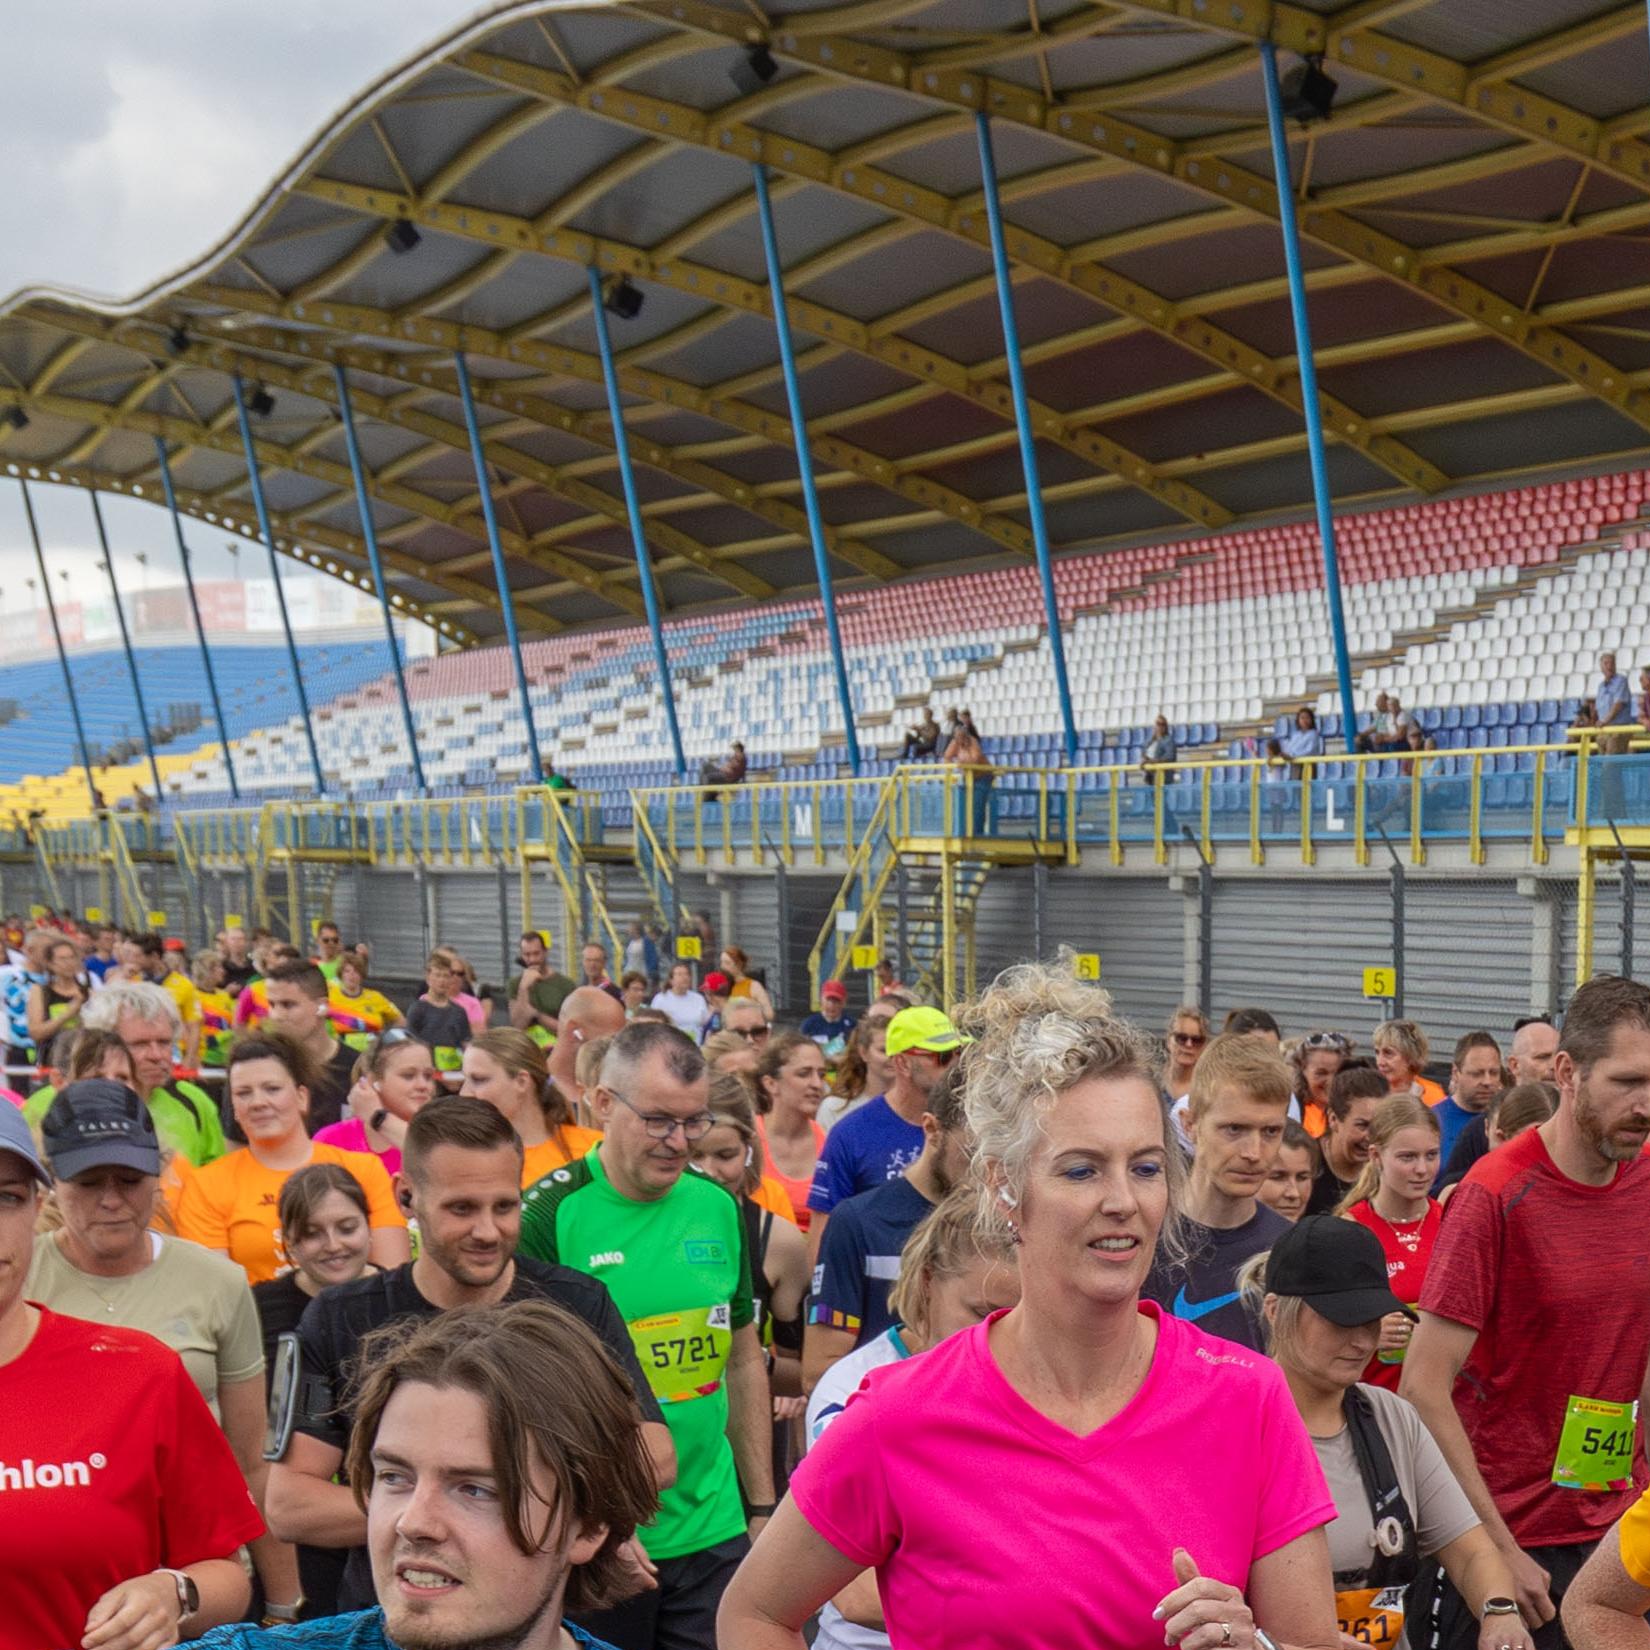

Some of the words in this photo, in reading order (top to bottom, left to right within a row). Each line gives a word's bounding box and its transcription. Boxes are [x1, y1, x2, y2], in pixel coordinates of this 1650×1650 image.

[794, 804, 812, 836] M
[1326, 788, 1344, 830] L
[684, 940, 695, 957] 8
[1078, 957, 1092, 978] 6
[1372, 972, 1385, 995] 5
[588, 1251, 625, 1268] JAKO
[651, 1333, 720, 1369] 5721
